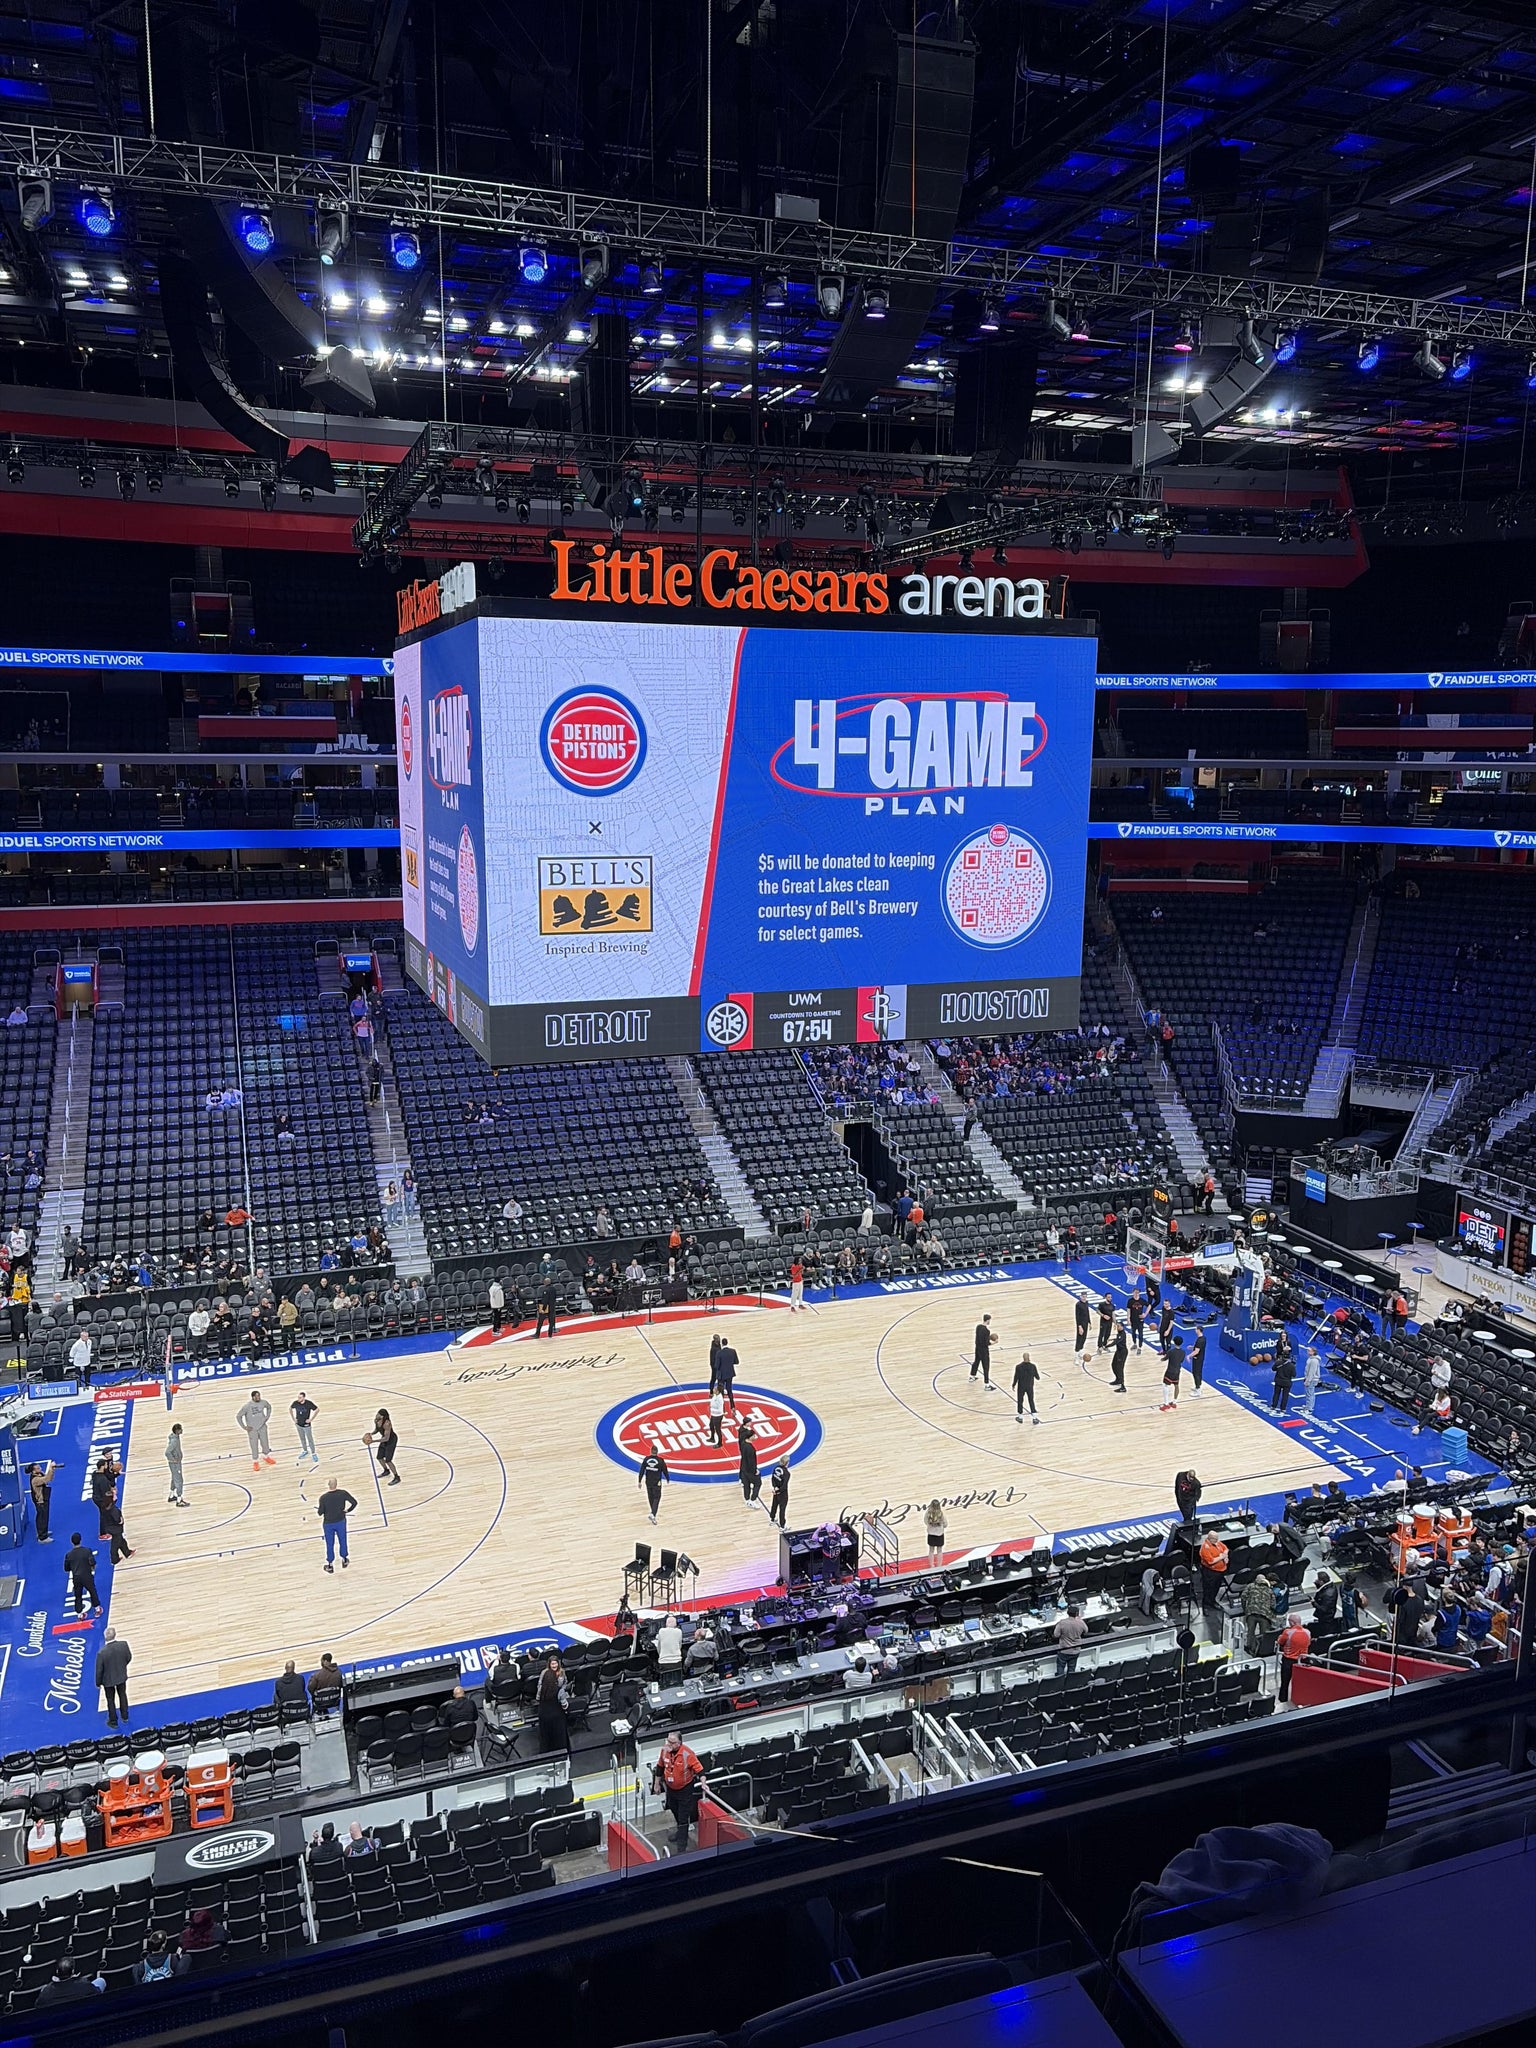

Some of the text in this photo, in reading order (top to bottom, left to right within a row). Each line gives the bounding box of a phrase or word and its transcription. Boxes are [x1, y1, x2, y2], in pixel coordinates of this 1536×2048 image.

[549, 540, 1044, 618] Little Caesars arena
[32, 653, 81, 664] SPORTS
[84, 654, 144, 666] NETWORK
[1133, 677, 1169, 686] SPORTS
[1171, 677, 1218, 686] NETWORK
[1445, 675, 1496, 684] FANDUEL
[562, 723, 625, 741] DETROIT
[562, 742, 626, 760] PISTONS
[794, 699, 1036, 789] 4-GAME
[441, 790, 460, 811] PLAN
[865, 796, 965, 816] PLAN
[1134, 825, 1277, 837] FANDUEL SPORTS NETWORK
[44, 836, 96, 847] SPORTS
[100, 835, 164, 846] NETWORK
[758, 852, 936, 873] $5 will be donated to keeping
[547, 861, 645, 887] BELL'S
[758, 876, 889, 895] the Great Lakes clean
[758, 899, 919, 921] courtesy of Bell's Brewery
[758, 925, 863, 943] for select games.
[544, 941, 648, 956] Inspired Brewing
[789, 993, 822, 1006] UWM
[940, 988, 1049, 1023] HOUSTON
[769, 1012, 805, 1020] COUNTDOWN
[545, 1009, 651, 1047] DETROIT
[783, 1019, 832, 1043] 67:54
[1466, 1218, 1498, 1241] DET
[457, 1353, 626, 1384] Platinum Equity
[1299, 1429, 1377, 1477] ULTRA
[17, 1610, 48, 1657] Courtside
[44, 1637, 87, 1714] Michelob
[144, 1774, 156, 1785] G
[201, 1767, 215, 1780] G
[201, 1837, 259, 1856] PISTONS
[202, 1844, 259, 1861] DETROIT
